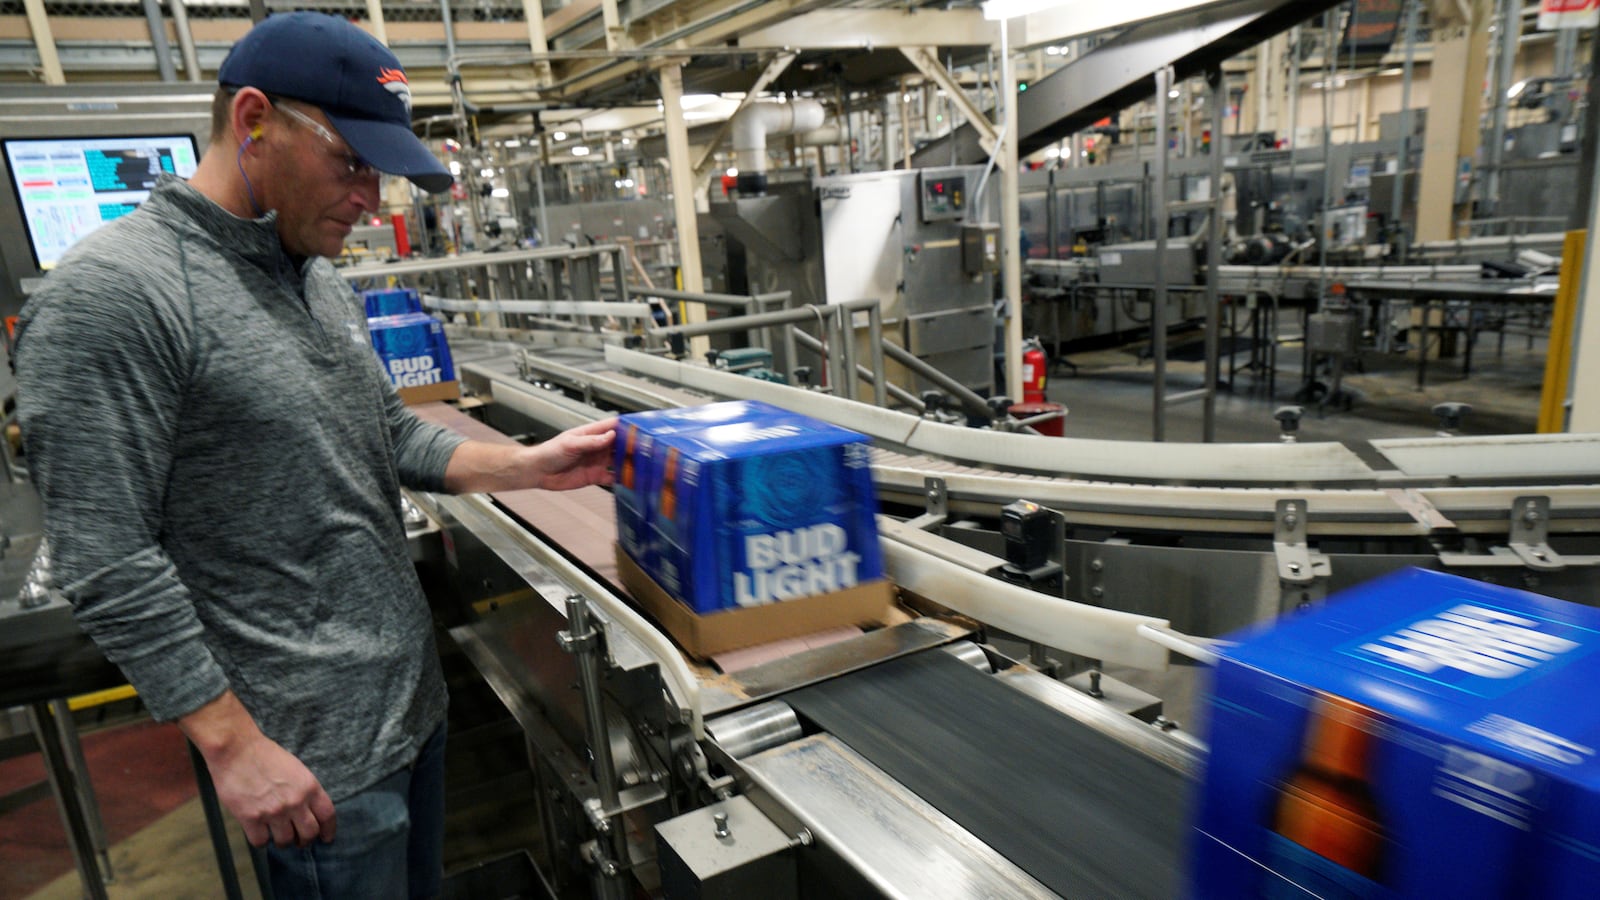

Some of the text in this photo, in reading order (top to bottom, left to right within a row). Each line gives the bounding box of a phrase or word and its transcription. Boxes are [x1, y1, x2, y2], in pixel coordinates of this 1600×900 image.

[389, 355, 434, 375] BUD
[744, 522, 848, 569] BUD
[733, 550, 862, 608] LIGHT
